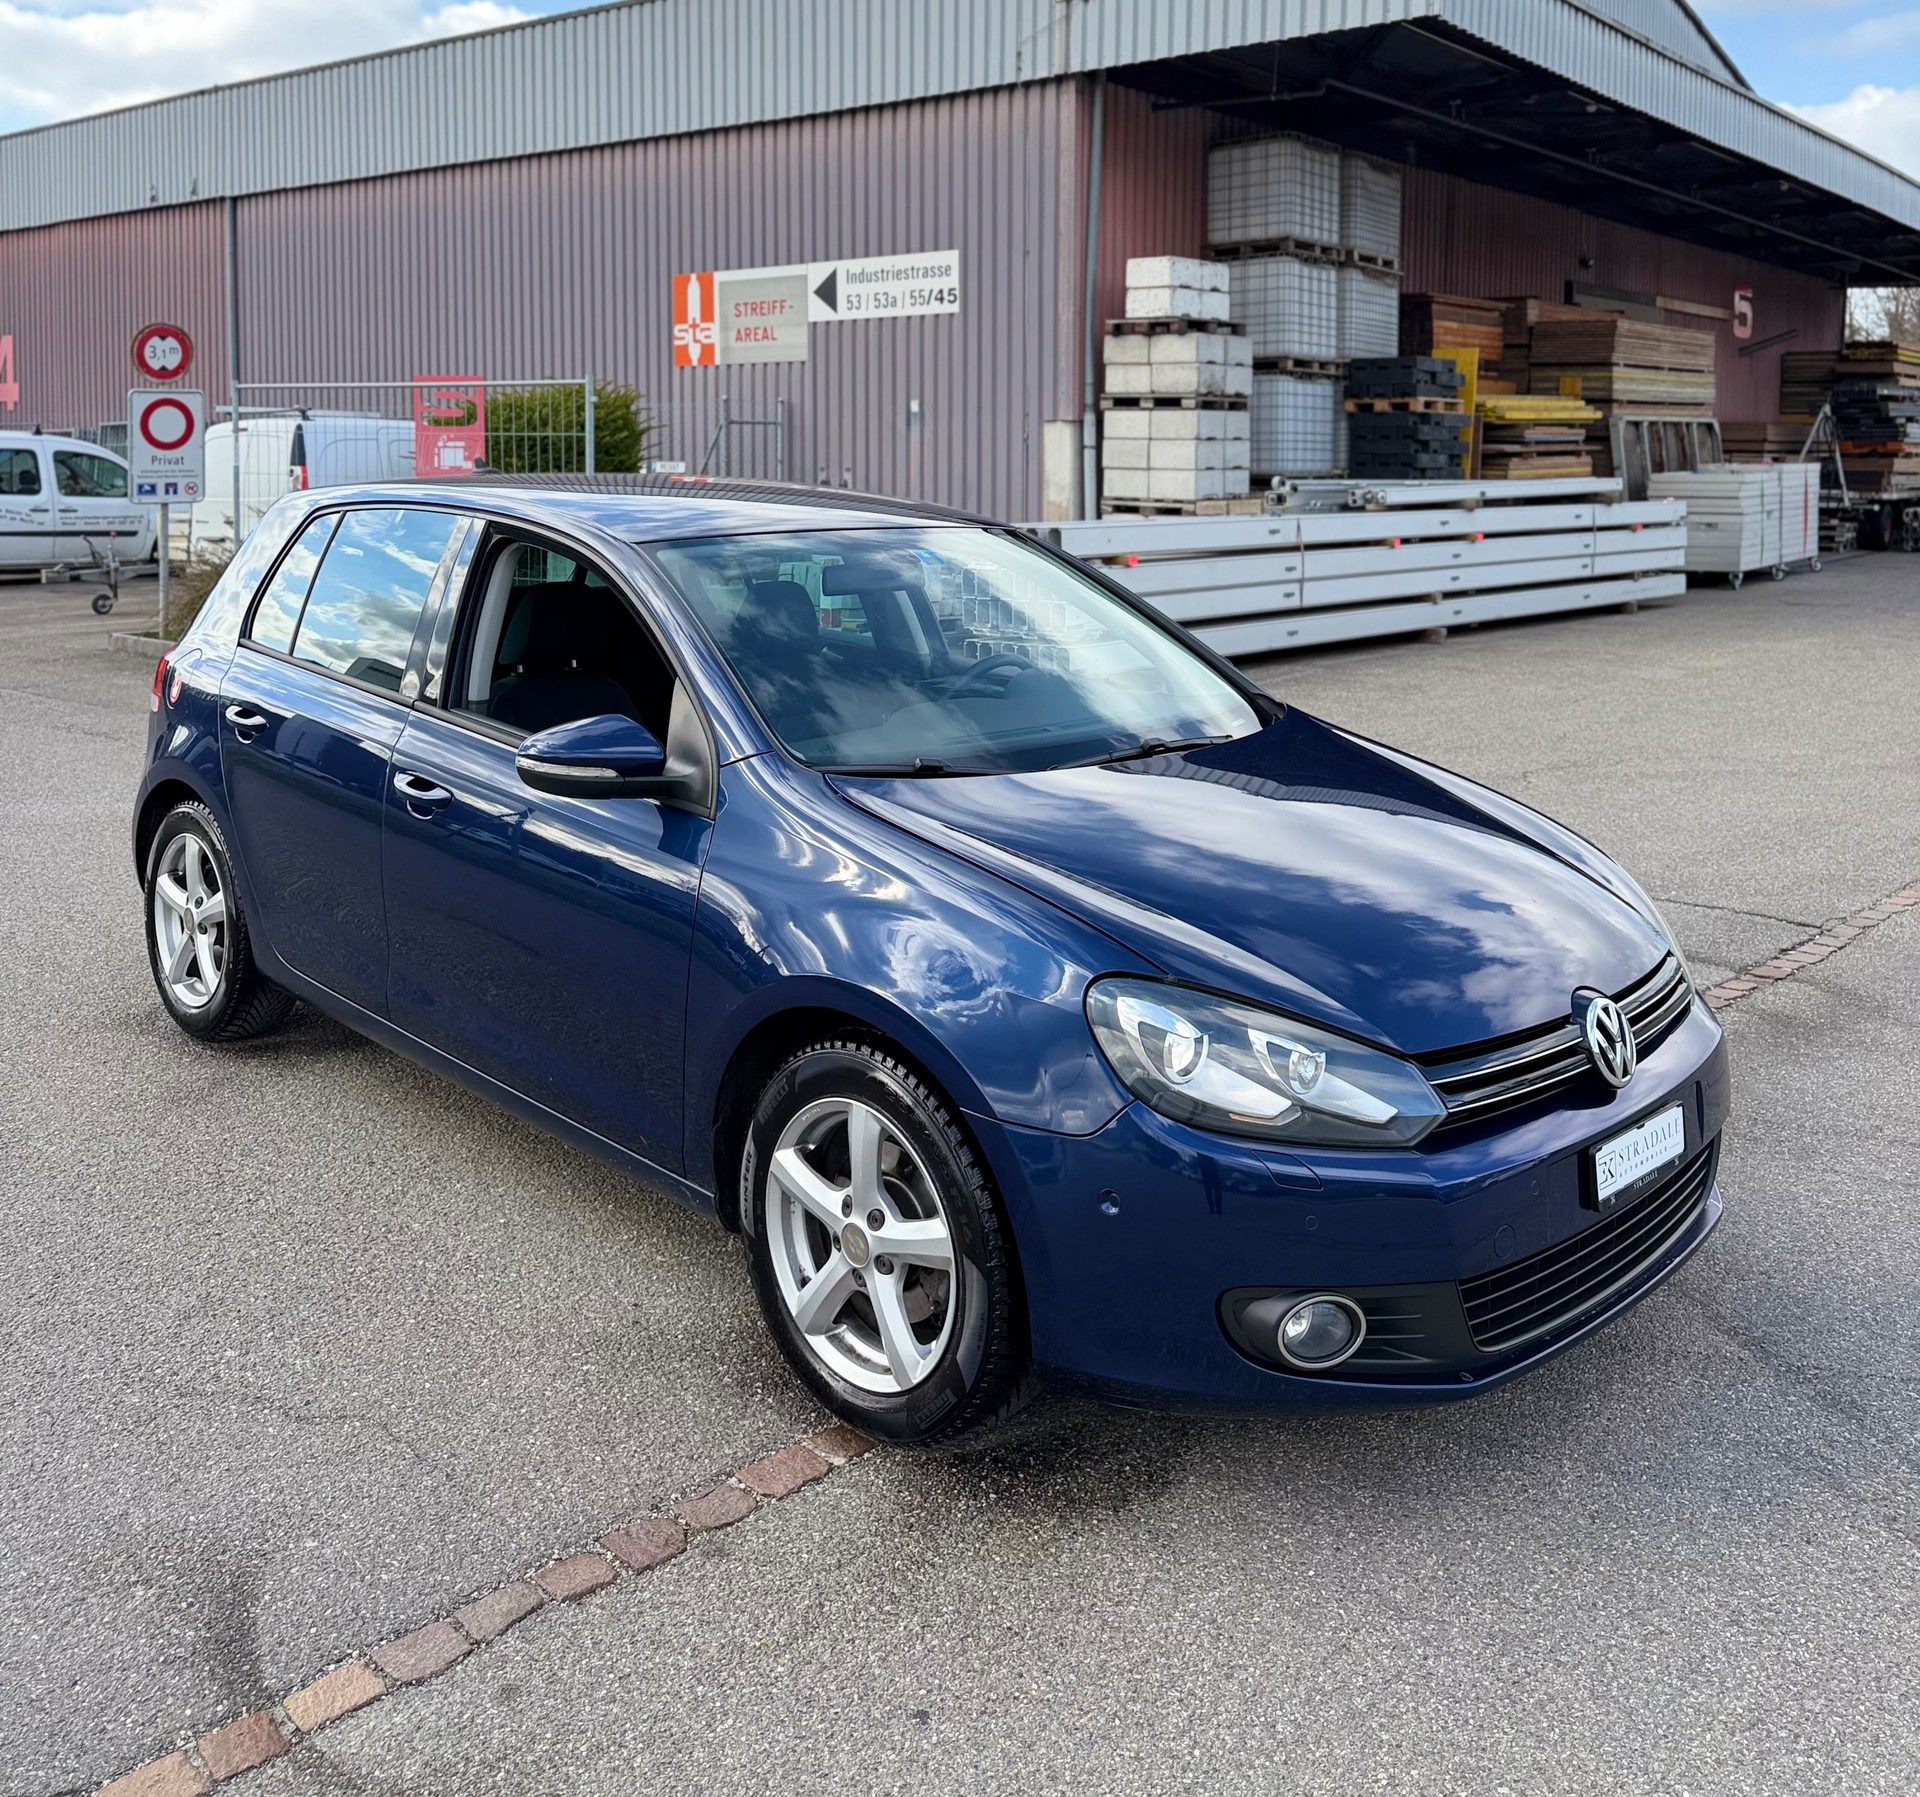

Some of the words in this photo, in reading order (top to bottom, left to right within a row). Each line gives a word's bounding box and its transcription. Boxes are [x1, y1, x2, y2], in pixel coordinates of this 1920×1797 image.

[846, 264, 952, 286] Industriestrasse
[734, 299, 795, 319] STREIFF-
[846, 294, 862, 312] 53
[874, 291, 898, 310] 53a
[909, 287, 958, 307] 55/45
[1733, 283, 1753, 339] 5
[673, 317, 714, 345] sta
[735, 326, 778, 343] AREAL
[0, 335, 20, 411] 4
[151, 454, 185, 466] Privat
[1618, 1116, 1681, 1167] STRADALE
[743, 1153, 753, 1220] WINTER
